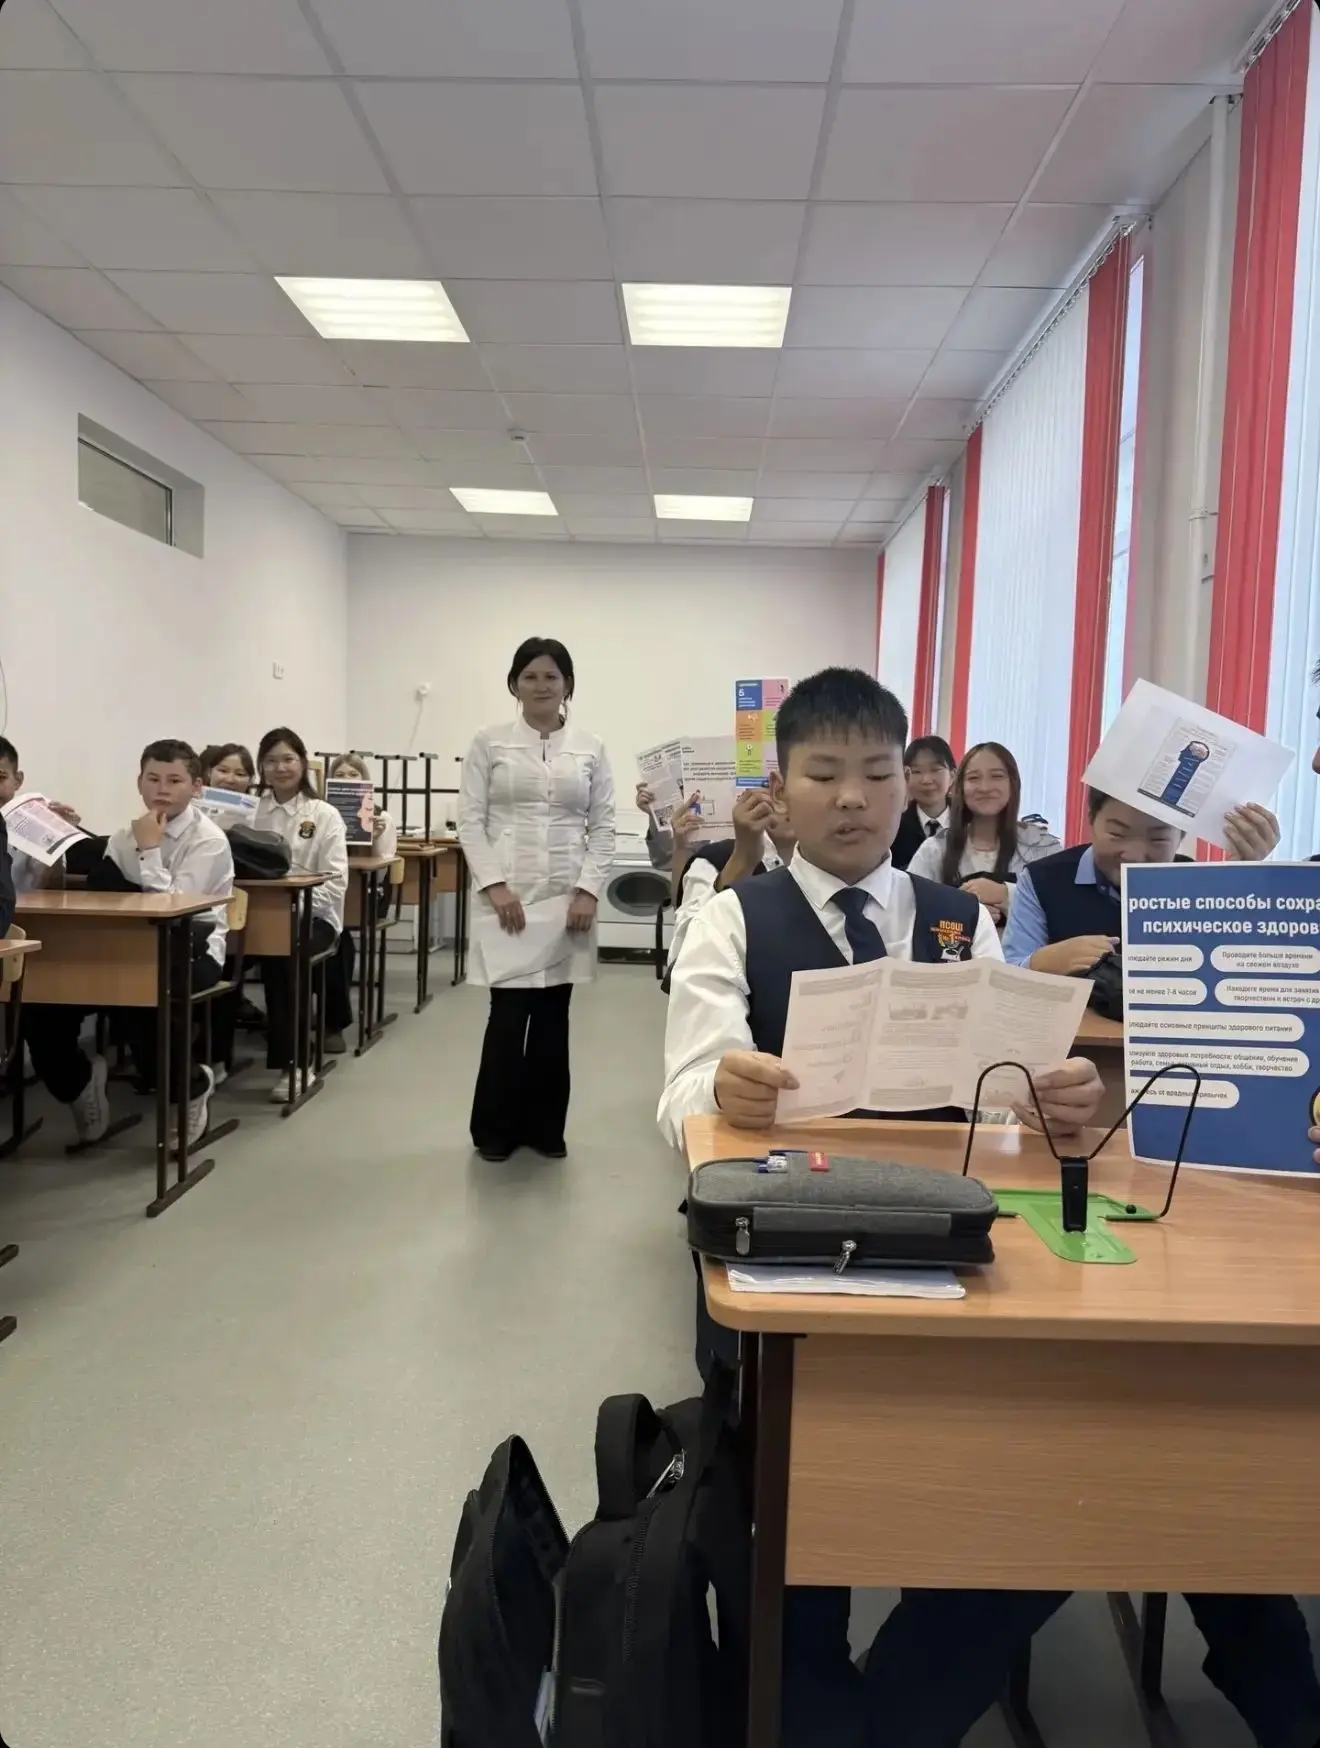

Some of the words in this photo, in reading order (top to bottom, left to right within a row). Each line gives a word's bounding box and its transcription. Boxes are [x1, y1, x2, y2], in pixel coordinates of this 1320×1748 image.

[1128, 897, 1191, 913] ростые
[1195, 894, 1271, 910] способы
[1143, 921, 1253, 934] психическое
[1257, 921, 1320, 937] здоров
